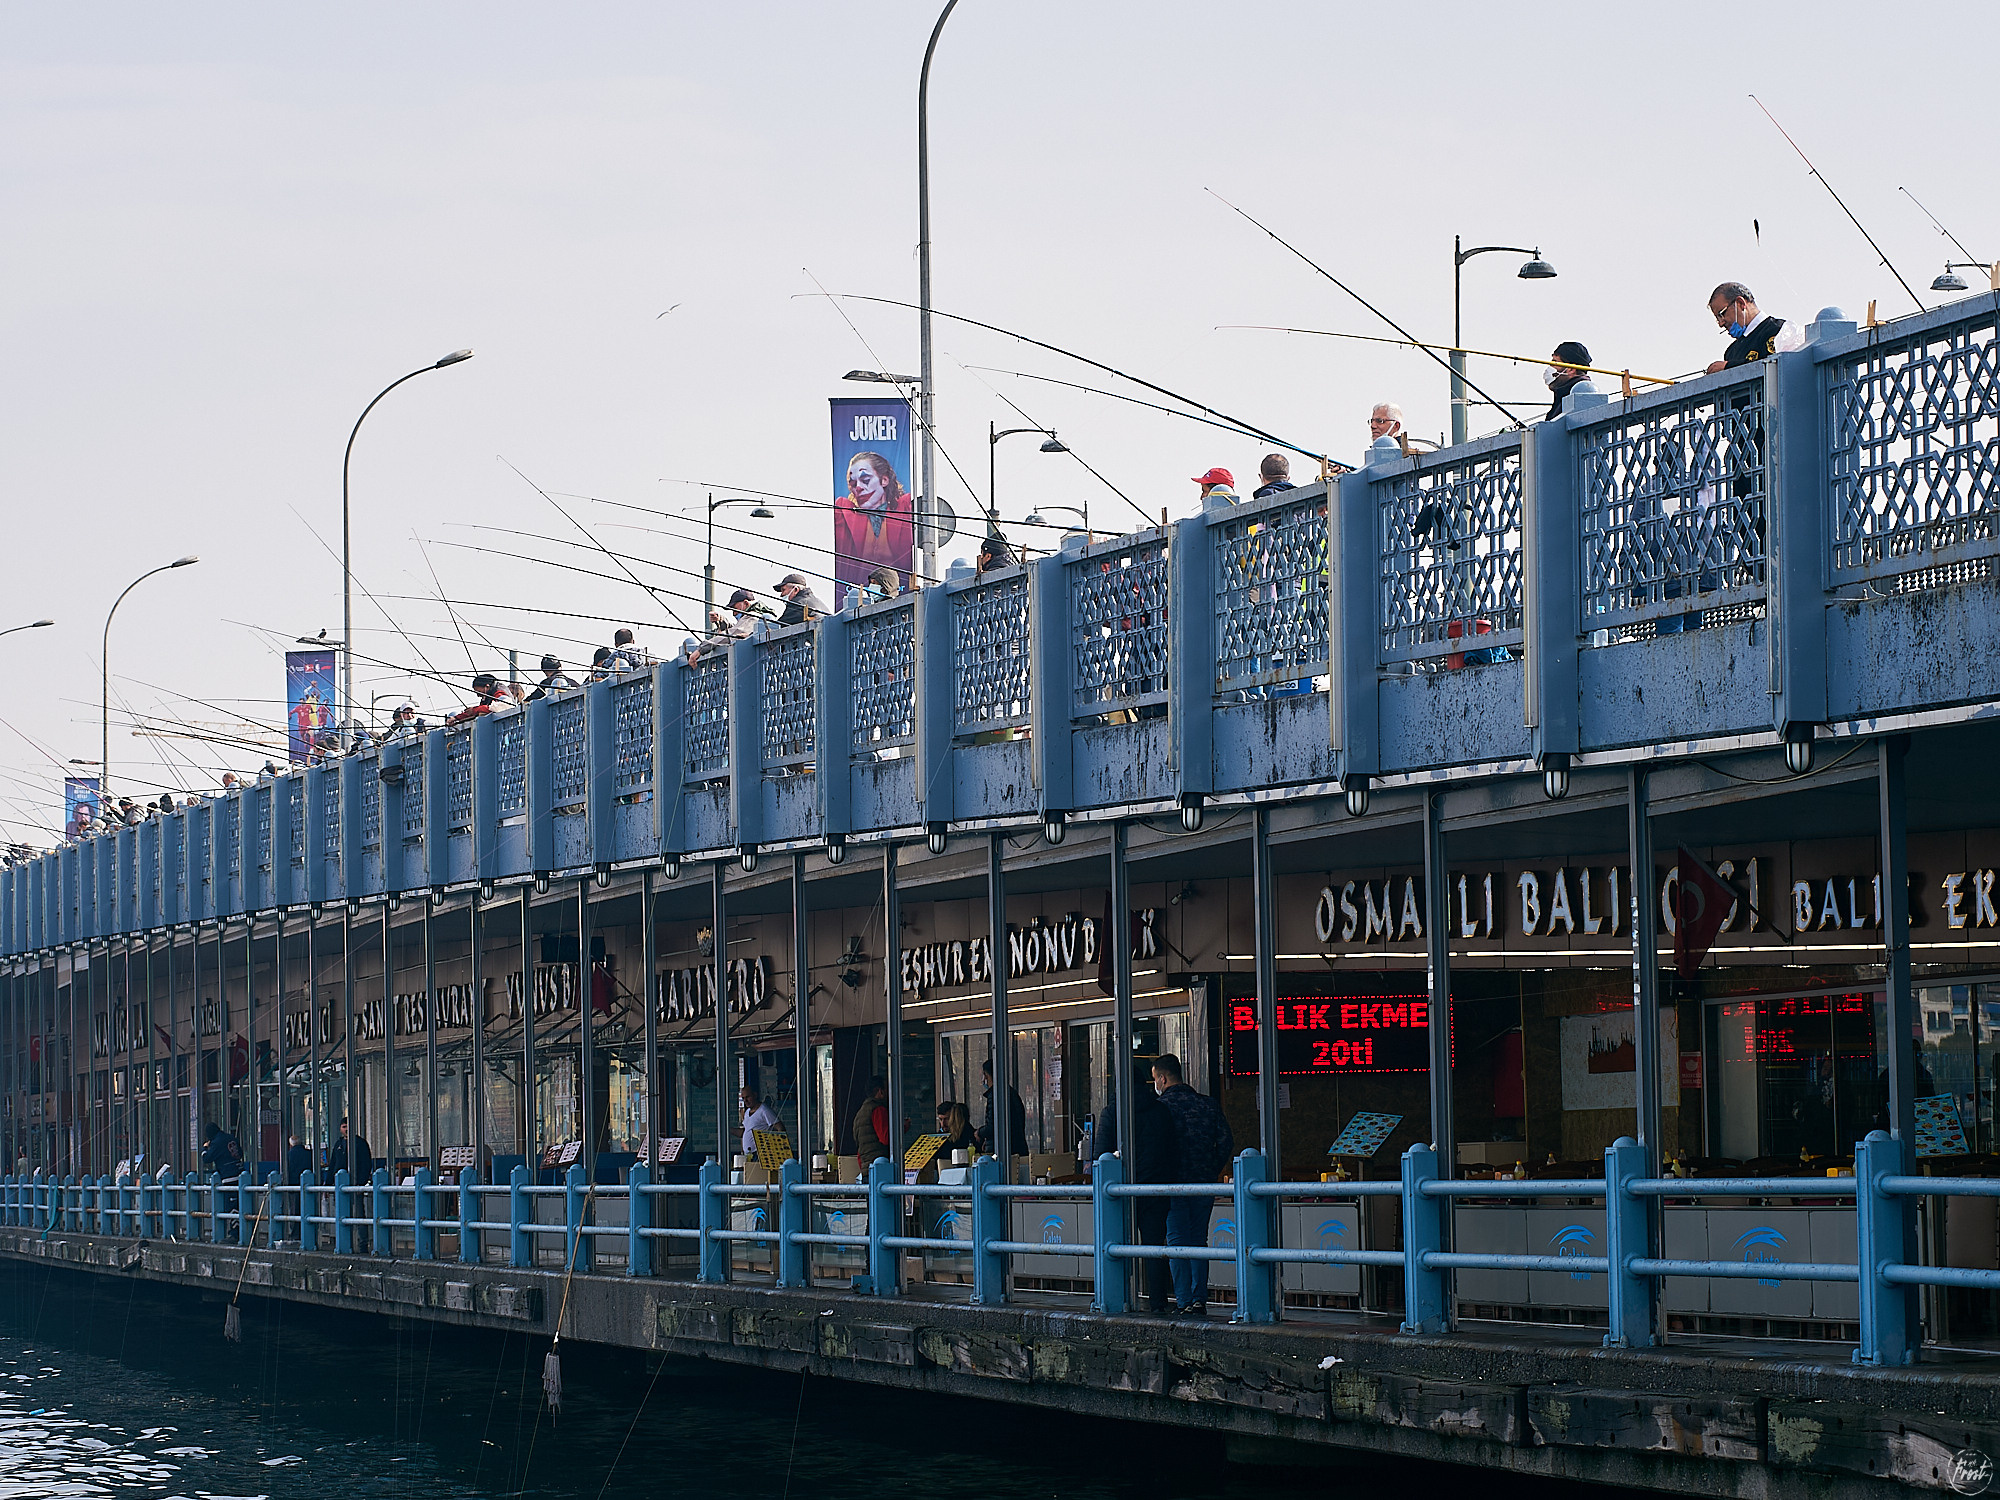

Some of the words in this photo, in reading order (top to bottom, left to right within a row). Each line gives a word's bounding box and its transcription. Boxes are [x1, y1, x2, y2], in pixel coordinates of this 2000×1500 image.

[849, 415, 897, 441] JOKER
[1315, 872, 1492, 944] OSMALI
[1791, 872, 1913, 932] BALI
[885, 940, 965, 1000] EŞHUR
[1233, 1003, 1331, 1031] BLIK
[1340, 1002, 1429, 1030] EKME
